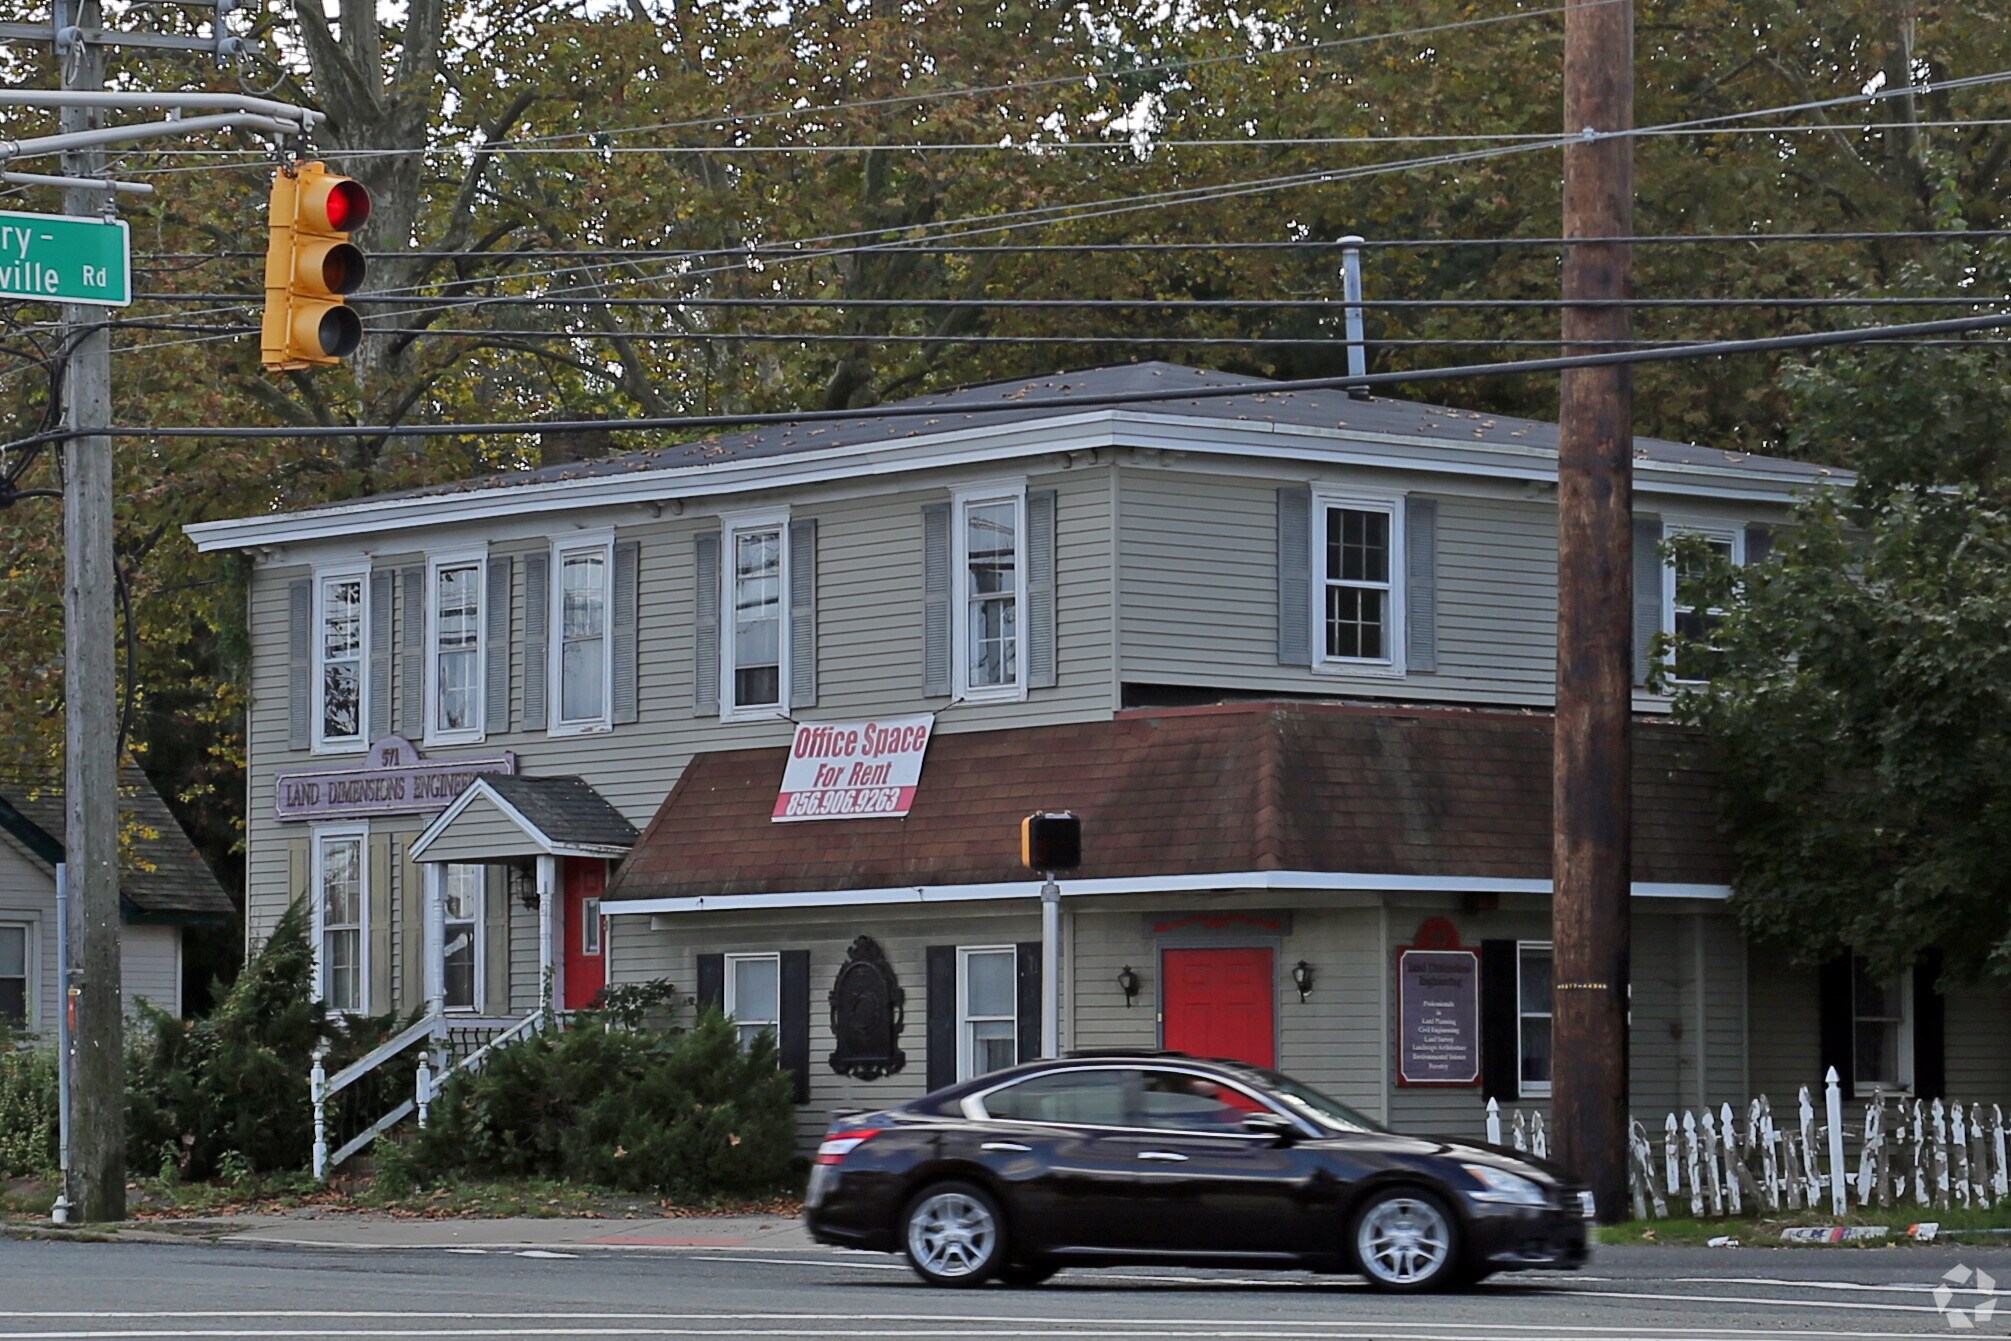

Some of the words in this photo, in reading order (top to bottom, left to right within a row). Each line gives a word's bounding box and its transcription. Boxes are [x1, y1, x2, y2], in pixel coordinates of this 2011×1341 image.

[0, 259, 60, 294] ville
[82, 264, 108, 288] Rd
[794, 725, 859, 760] Office
[861, 722, 927, 759] Space
[381, 747, 400, 767] 571
[812, 762, 846, 788] For
[848, 761, 893, 787] Rent
[286, 782, 320, 808] LAND
[328, 776, 405, 805] DIMENSIONS
[786, 787, 901, 816] 856.906.9263
[1421, 1017, 1435, 1025] Land
[1435, 1017, 1457, 1026] Planning
[1418, 1026, 1431, 1034] Civil
[1431, 1026, 1460, 1036] Engineering
[1424, 1035, 1437, 1043] Land
[1412, 1044, 1438, 1053] Landscape
[1412, 1053, 1448, 1061] Environmental
[1428, 1062, 1449, 1071] Forestry
